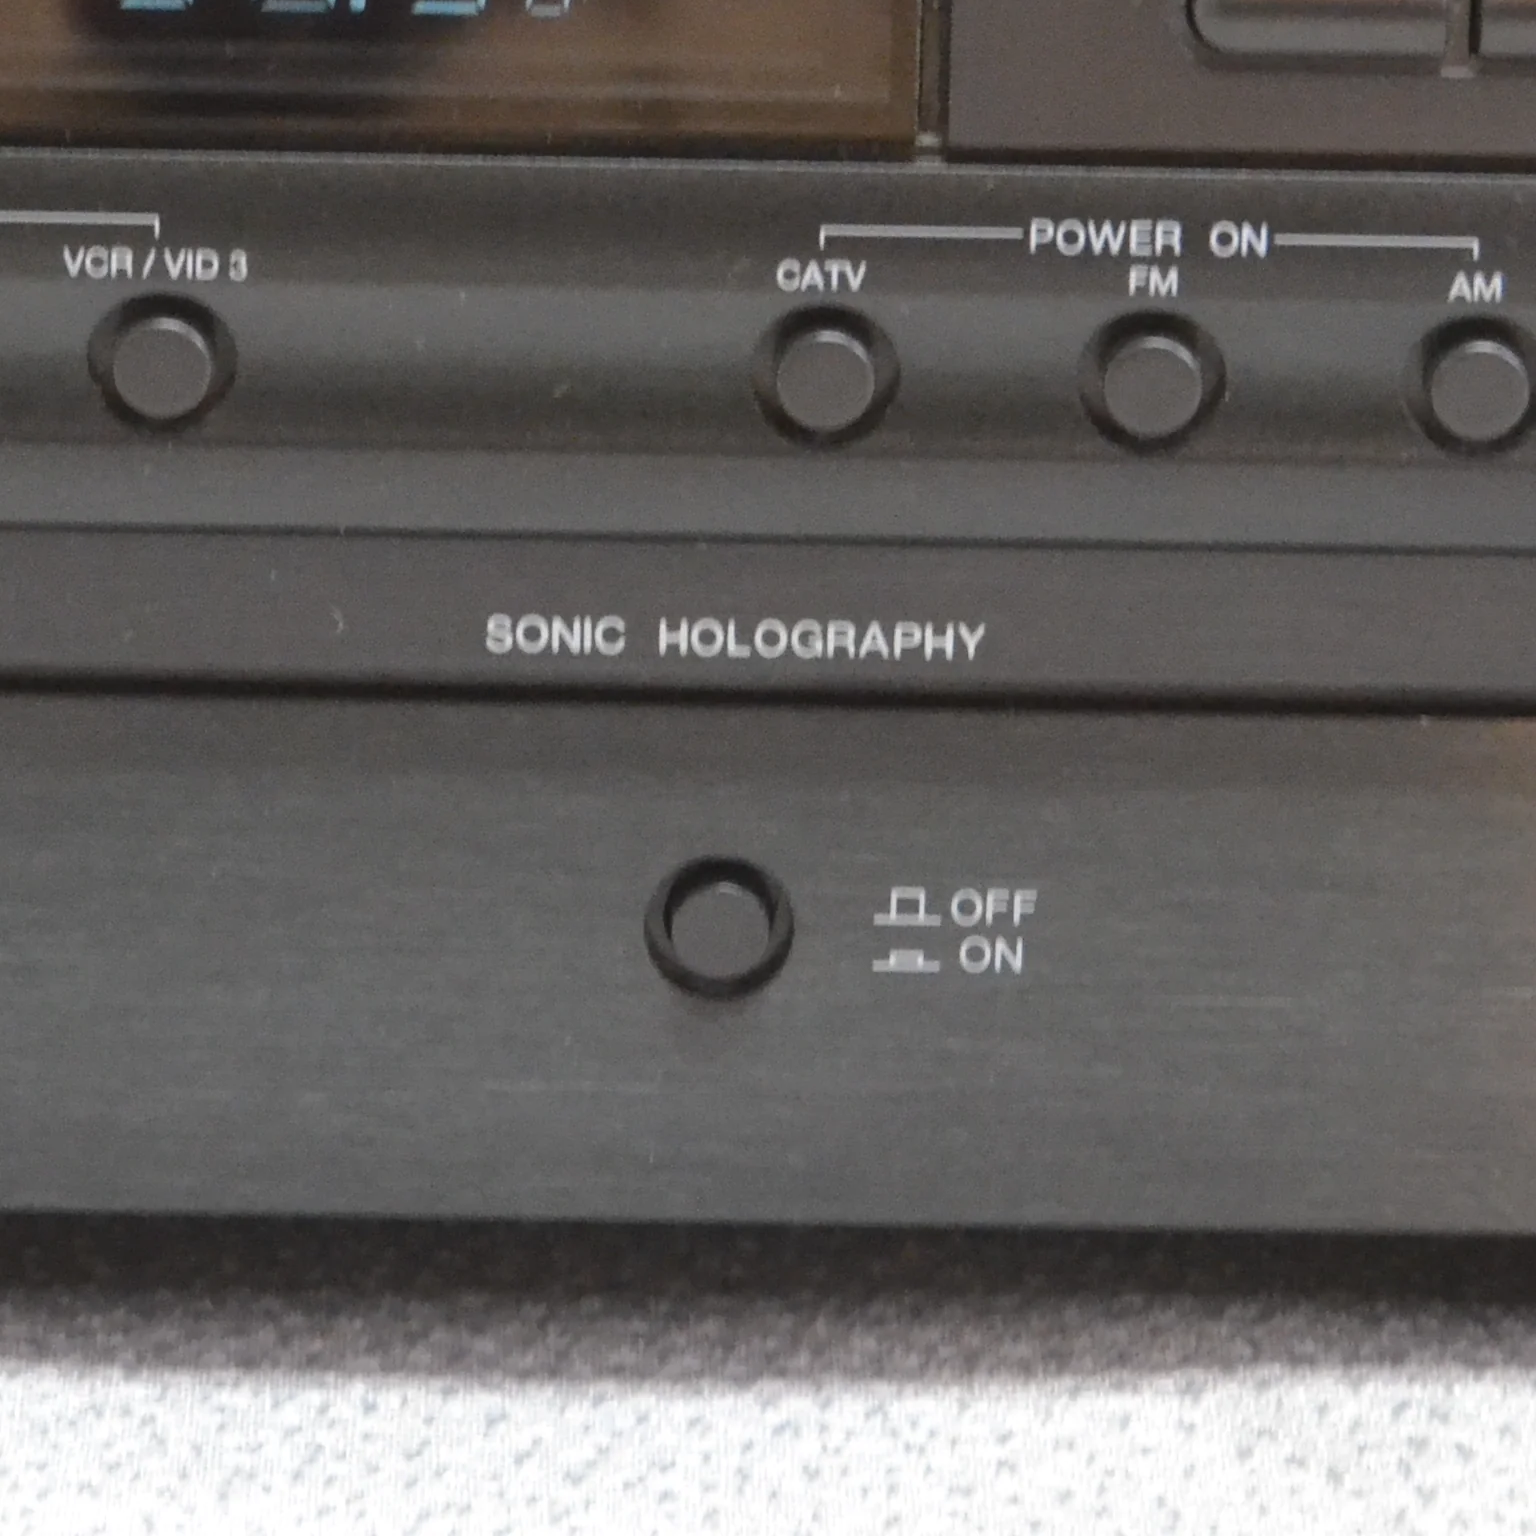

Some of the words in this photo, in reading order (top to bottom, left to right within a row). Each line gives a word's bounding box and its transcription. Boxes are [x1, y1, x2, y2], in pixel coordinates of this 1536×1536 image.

[1030, 217, 1181, 257] POWER
[1209, 220, 1268, 258] ON
[64, 244, 133, 279] VCR
[164, 246, 220, 281] VID
[776, 260, 867, 294] CATV
[1129, 263, 1179, 298] FM
[1448, 272, 1504, 305] AM
[485, 613, 627, 656] SONIC
[659, 616, 987, 662] HOLOGRAPHY
[950, 888, 1038, 927] OFF
[958, 936, 1024, 974] ON
